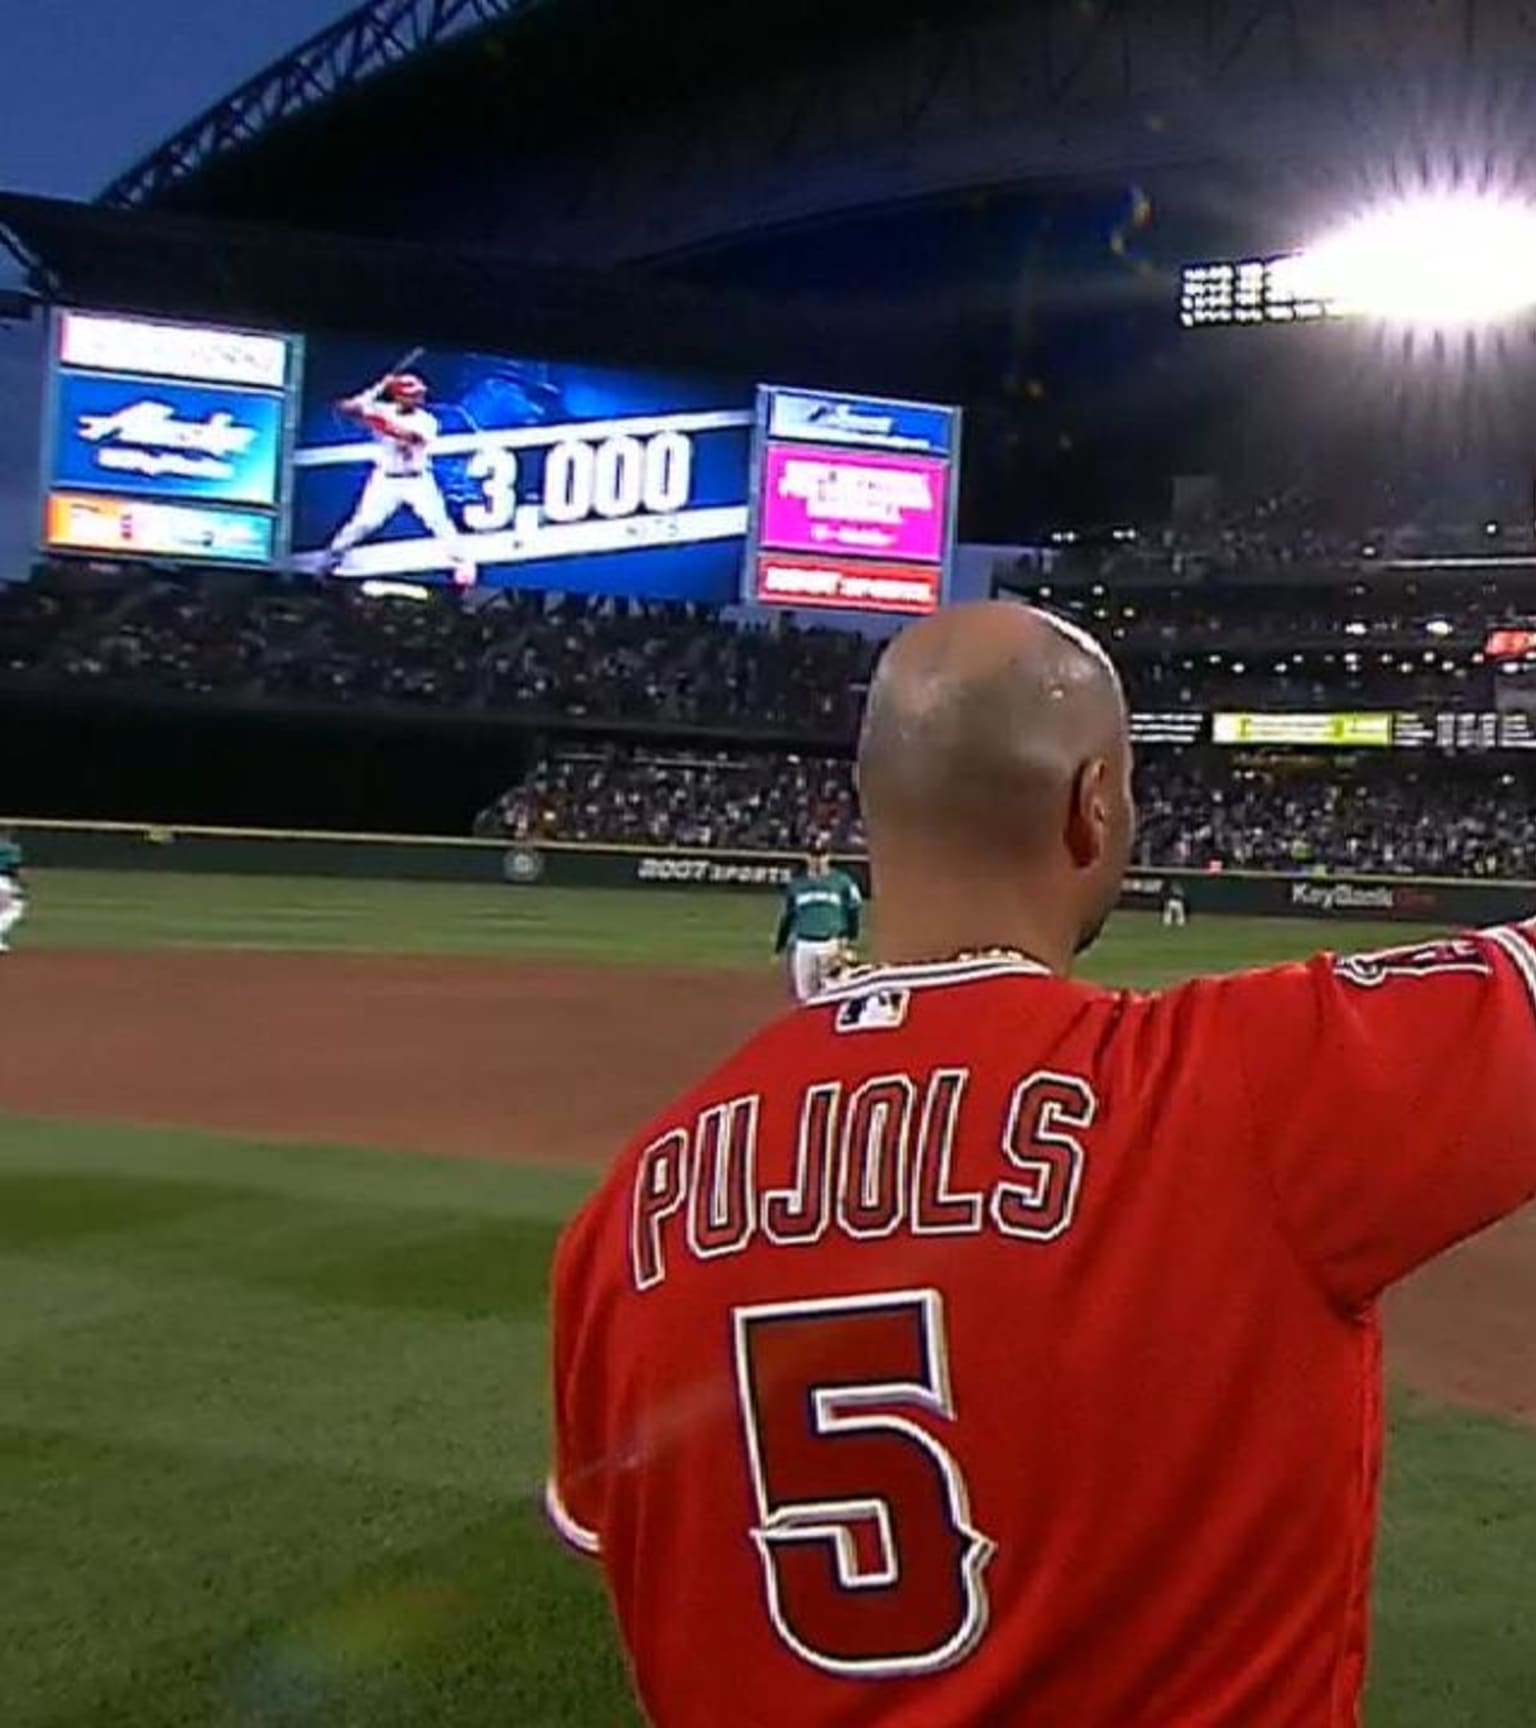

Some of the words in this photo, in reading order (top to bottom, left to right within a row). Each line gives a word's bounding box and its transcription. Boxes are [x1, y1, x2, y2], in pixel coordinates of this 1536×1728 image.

[464, 430, 691, 534] 3,000
[638, 858, 708, 880] ROOT
[708, 863, 792, 884] SPORTS
[1292, 882, 1394, 910] KeyBank
[632, 1067, 1096, 1290] PUJOLS
[733, 1287, 996, 1674] 5
